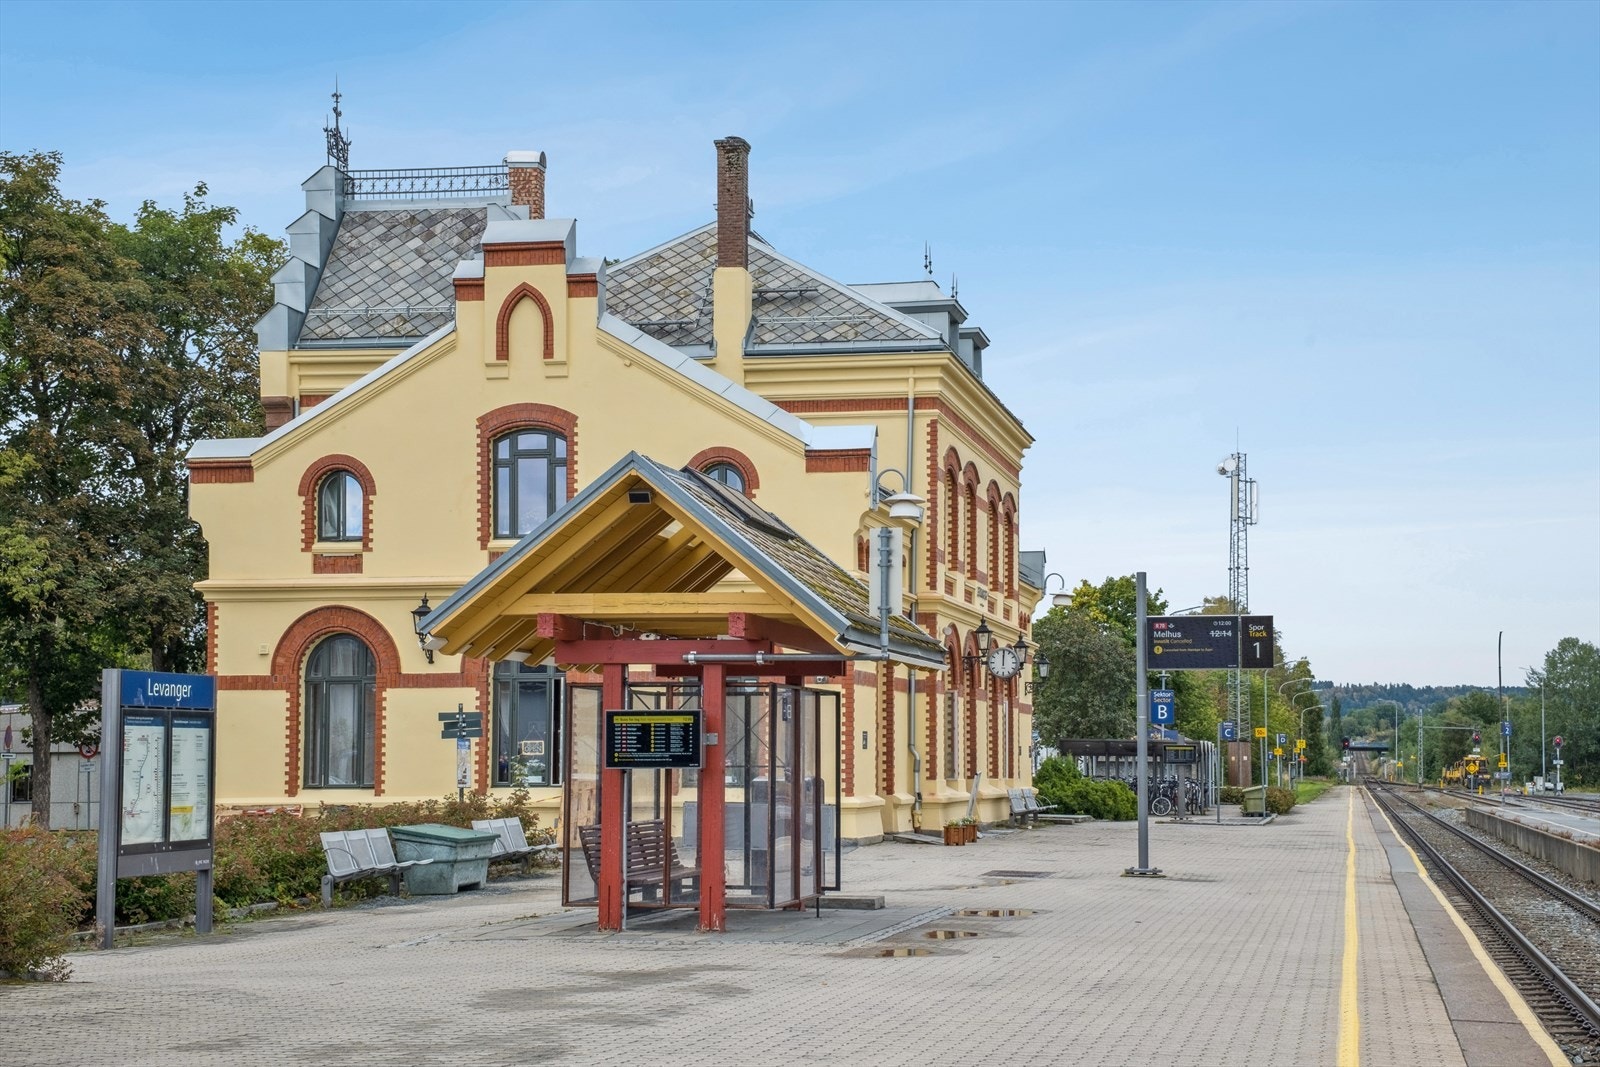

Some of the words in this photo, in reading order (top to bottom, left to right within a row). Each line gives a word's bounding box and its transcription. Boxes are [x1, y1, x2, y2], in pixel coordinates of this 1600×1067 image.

[1248, 623, 1265, 632] Spor
[1209, 630, 1232, 638] 12:14
[1253, 642, 1260, 658] 1
[148, 678, 192, 702] Levanger
[1158, 704, 1168, 719] B
[1224, 728, 1231, 737] C
[1505, 727, 1510, 735] 2
